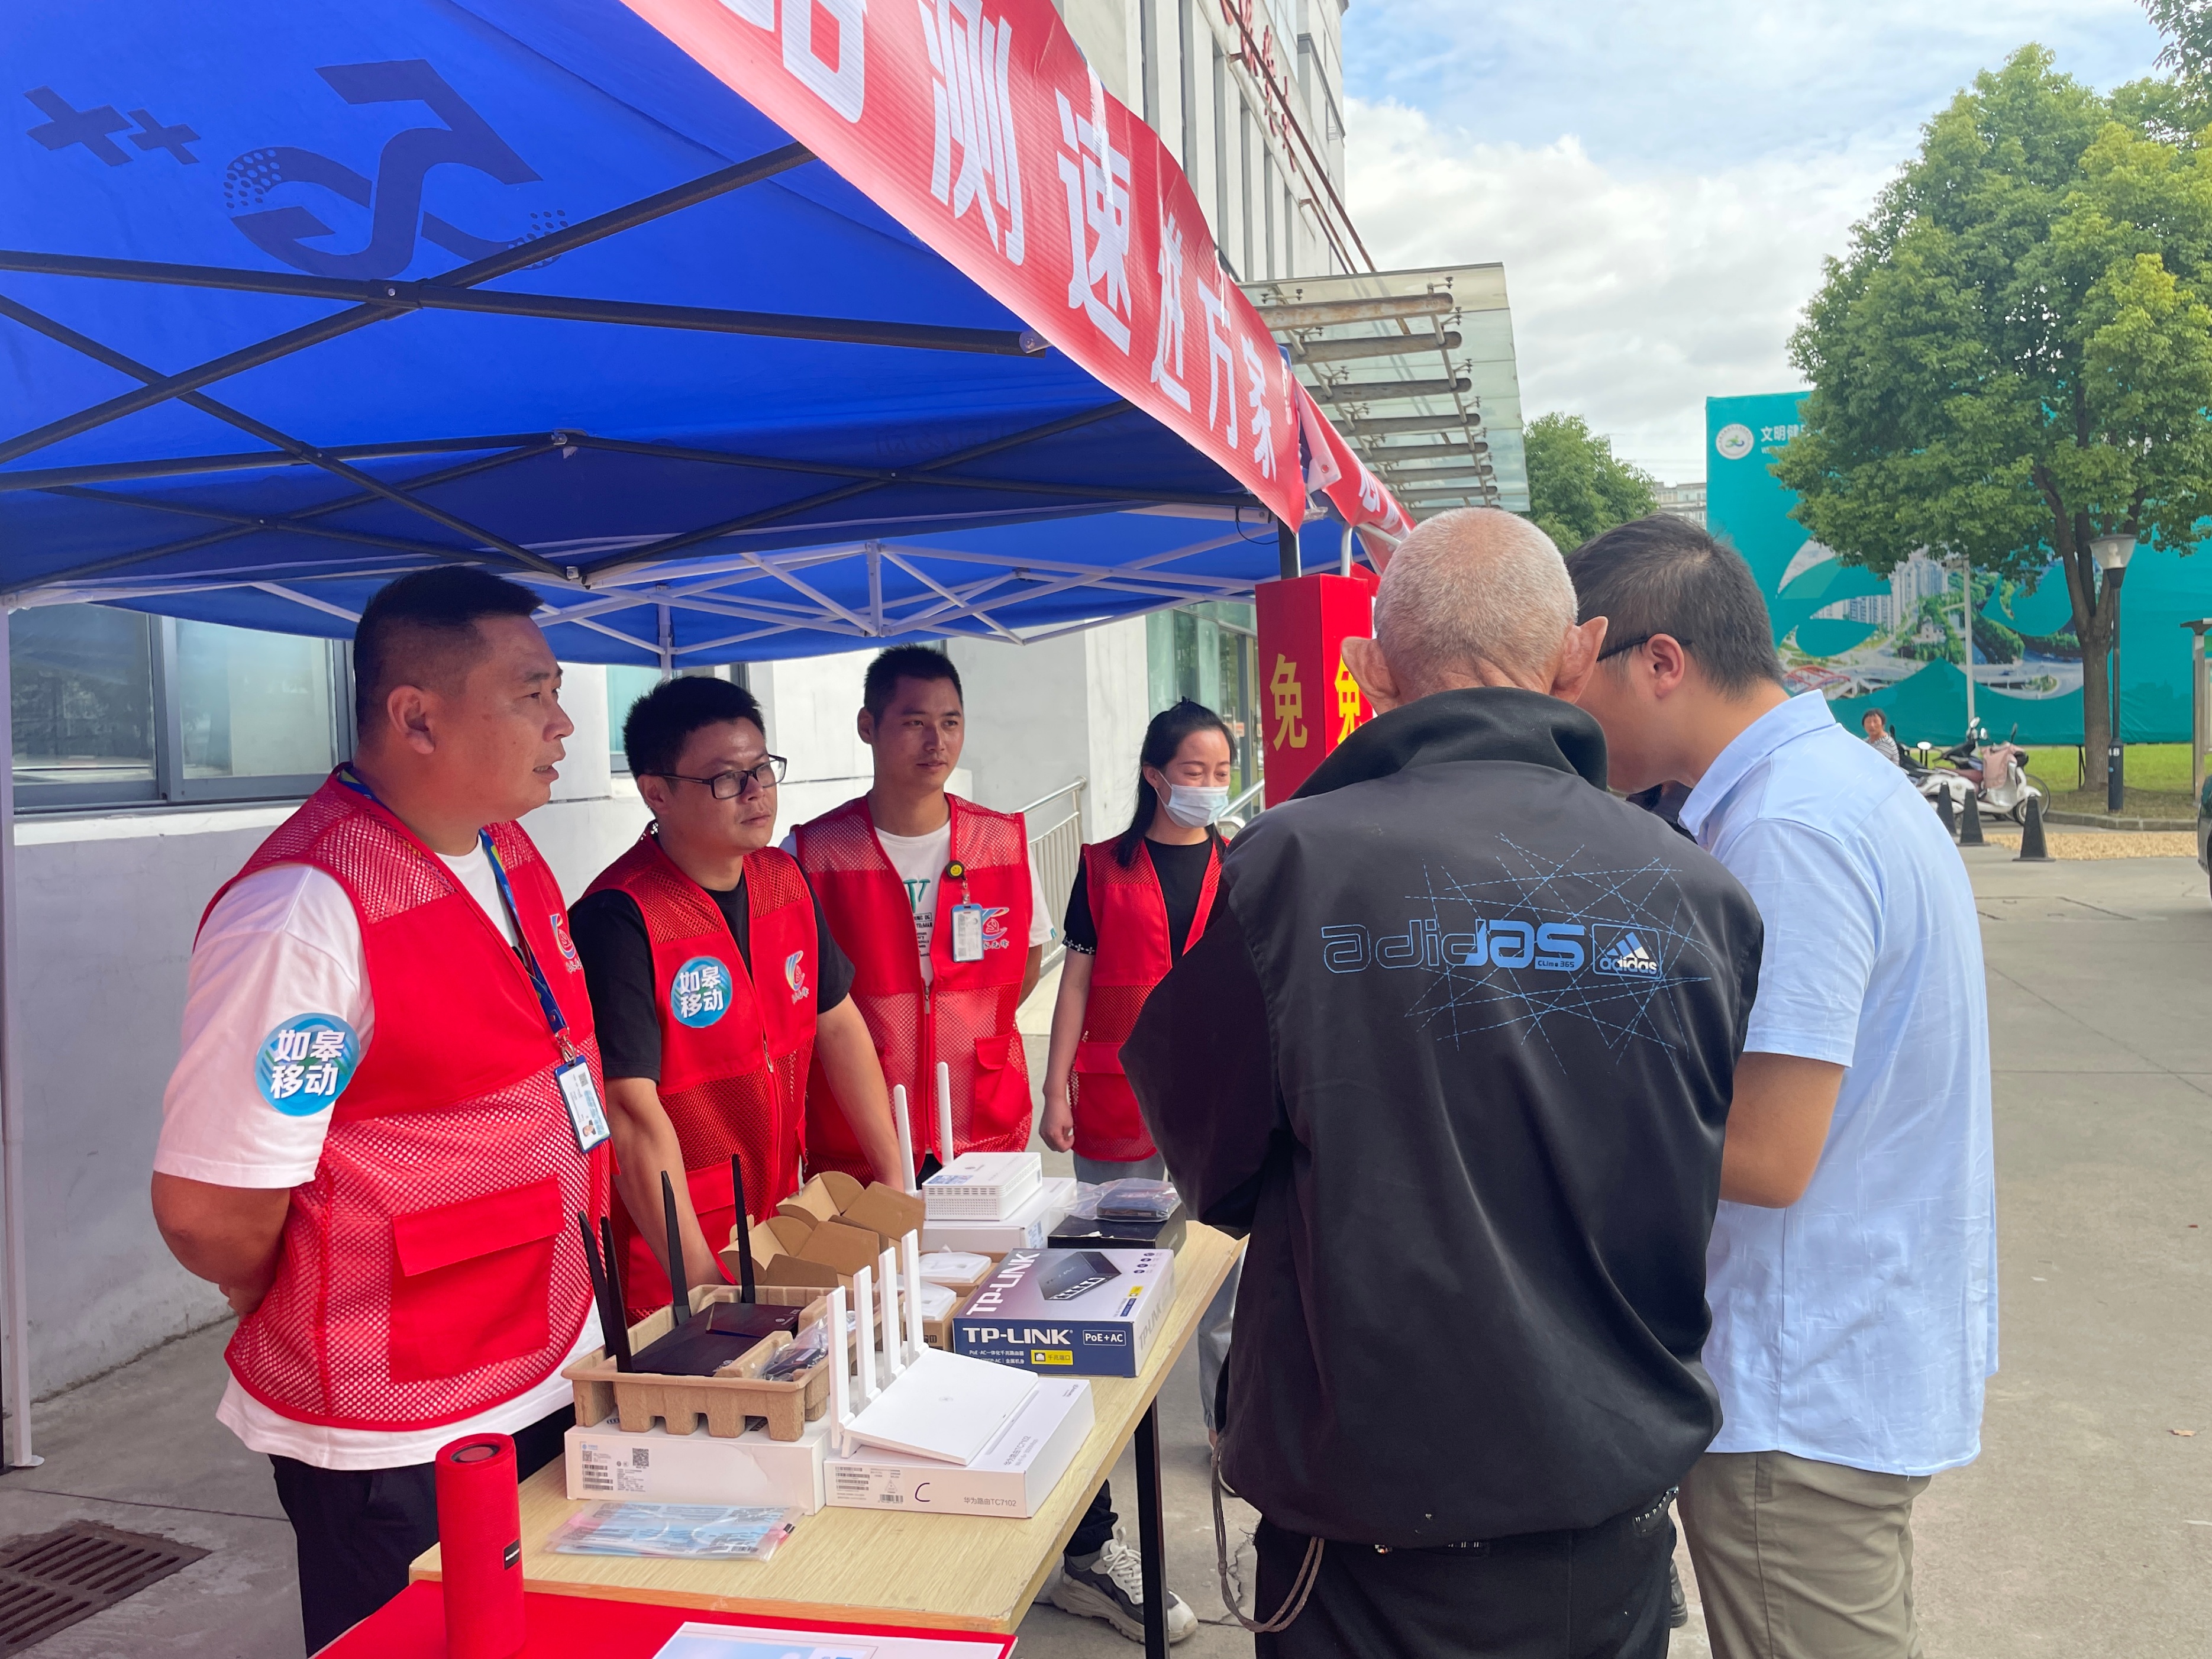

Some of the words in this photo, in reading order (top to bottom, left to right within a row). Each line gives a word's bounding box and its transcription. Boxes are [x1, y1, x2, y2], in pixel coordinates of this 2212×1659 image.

[1321, 919, 1585, 974] adidas
[1599, 955, 1658, 975] adidas
[680, 966, 721, 995] 如皋
[680, 989, 724, 1018] 移动
[274, 1029, 345, 1062] 如皋
[270, 1063, 339, 1099] 移动
[965, 1253, 1040, 1315] TP-LINK
[963, 1327, 1072, 1345] TP-LINK
[1084, 1333, 1123, 1342] PoE+AC
[915, 1482, 931, 1502] C
[963, 1496, 1017, 1508] 华为路由TC7102
